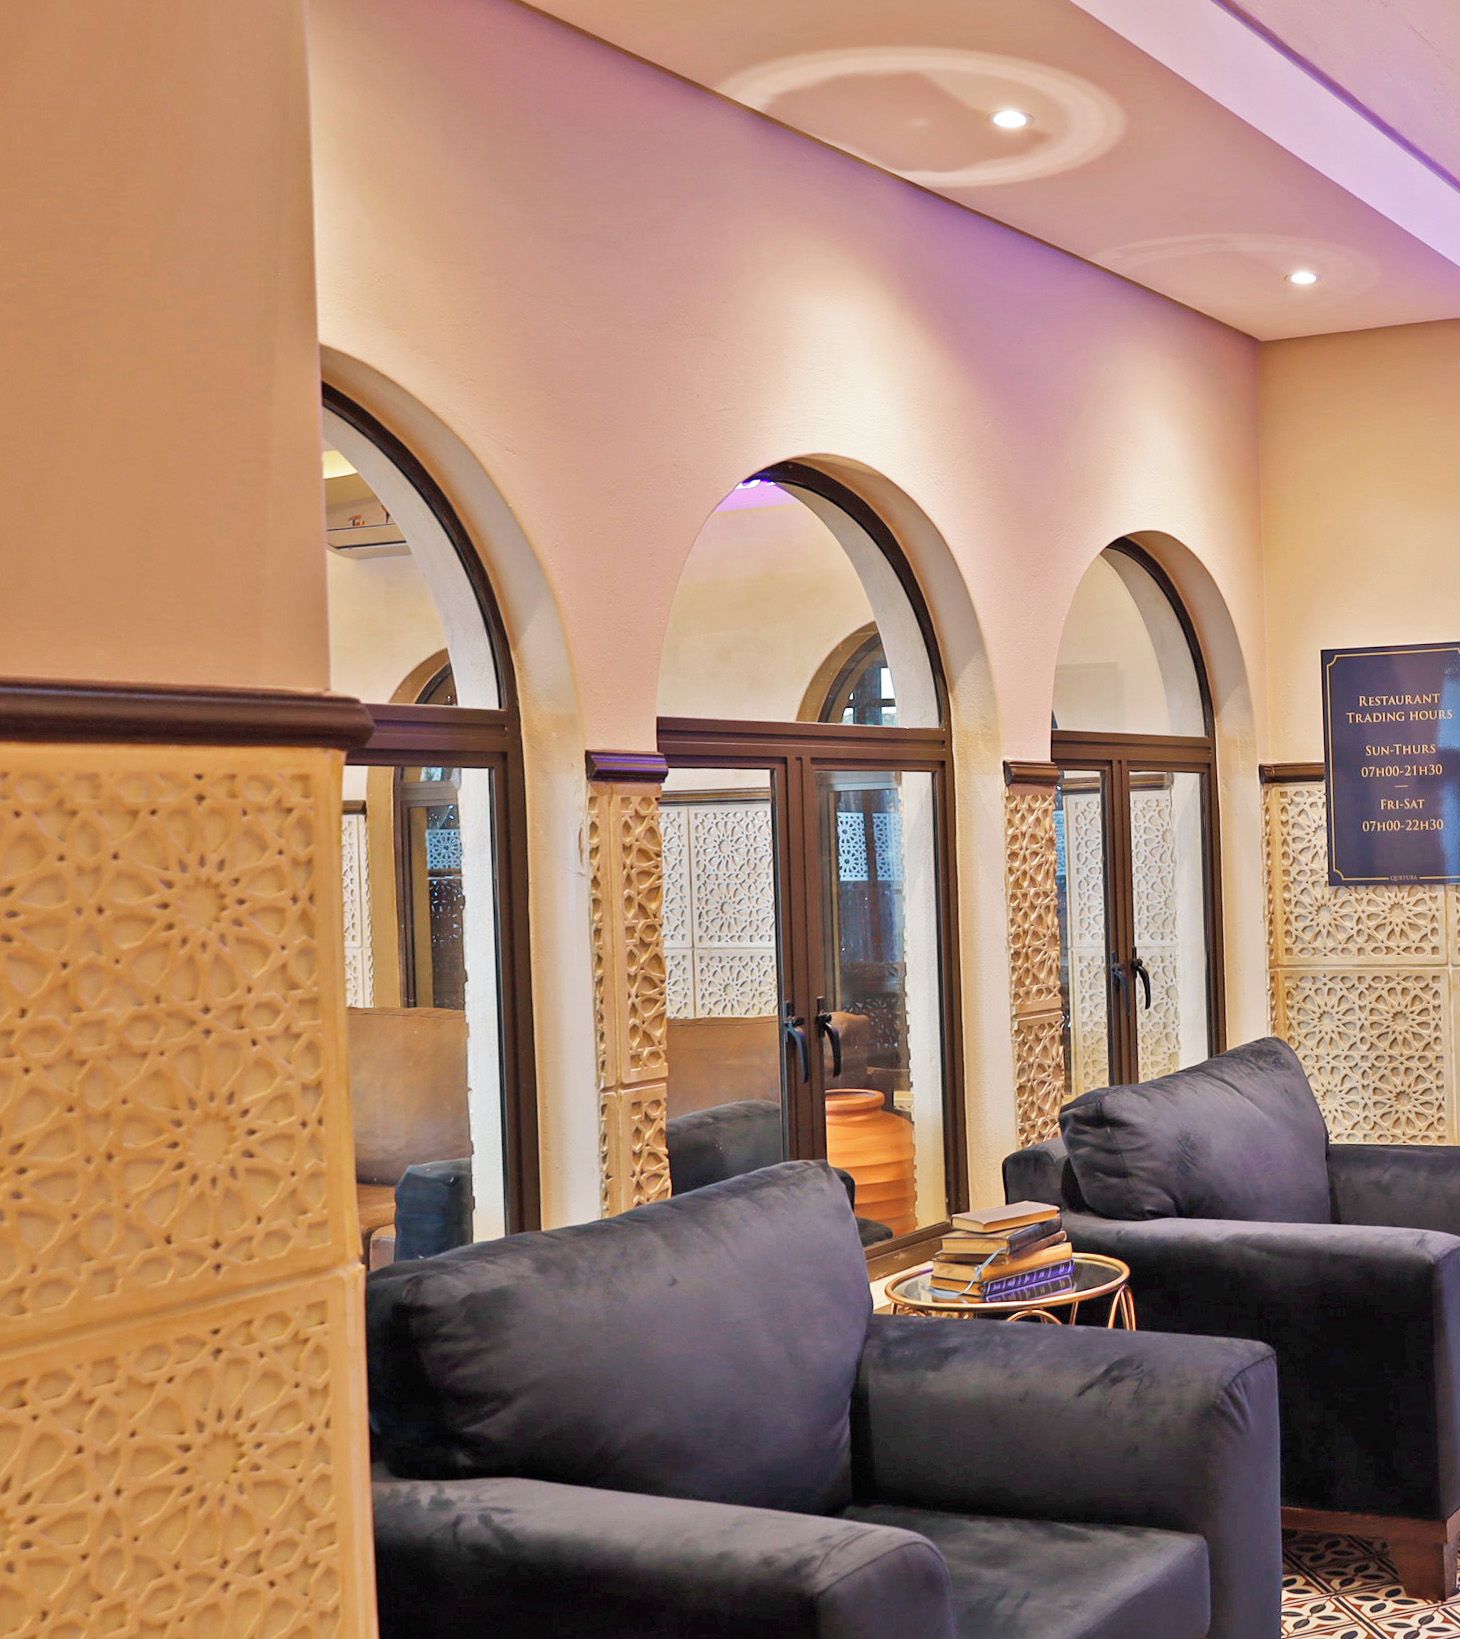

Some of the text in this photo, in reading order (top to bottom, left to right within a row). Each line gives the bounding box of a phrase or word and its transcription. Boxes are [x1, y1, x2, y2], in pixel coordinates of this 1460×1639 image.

[1358, 693, 1440, 707] RESTAURANT
[1346, 709, 1453, 723] TRADING HOURS
[1365, 744, 1436, 756] SUN-THURS
[1379, 799, 1424, 810] FRI-SAT
